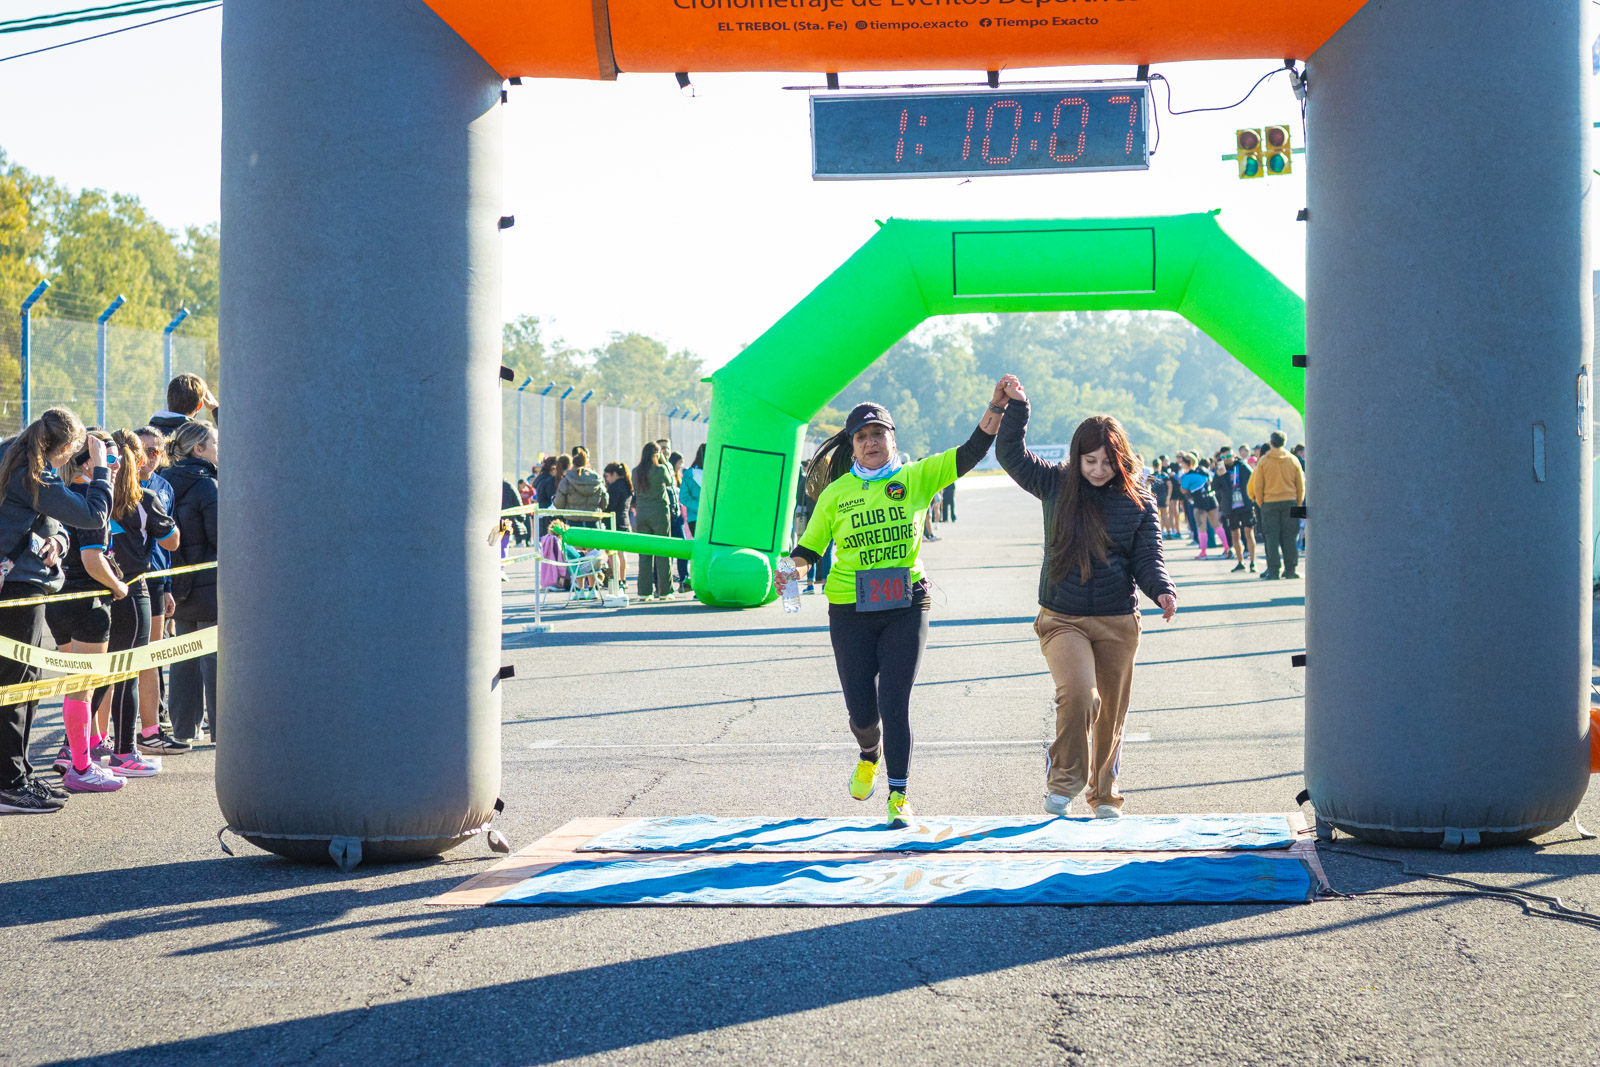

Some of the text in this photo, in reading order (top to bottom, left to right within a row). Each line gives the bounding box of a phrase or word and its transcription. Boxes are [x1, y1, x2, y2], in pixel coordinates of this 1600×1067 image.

[718, 16, 1099, 32] EL TREBOL (Sta. Fe) tiempo.exacto Tiempo Exacto
[851, 506, 907, 529] CLUB DE
[859, 543, 906, 565] RECREO
[869, 577, 903, 602] 240
[150, 640, 203, 662] PRECAUCION
[44, 656, 93, 670] PRECAUCION
